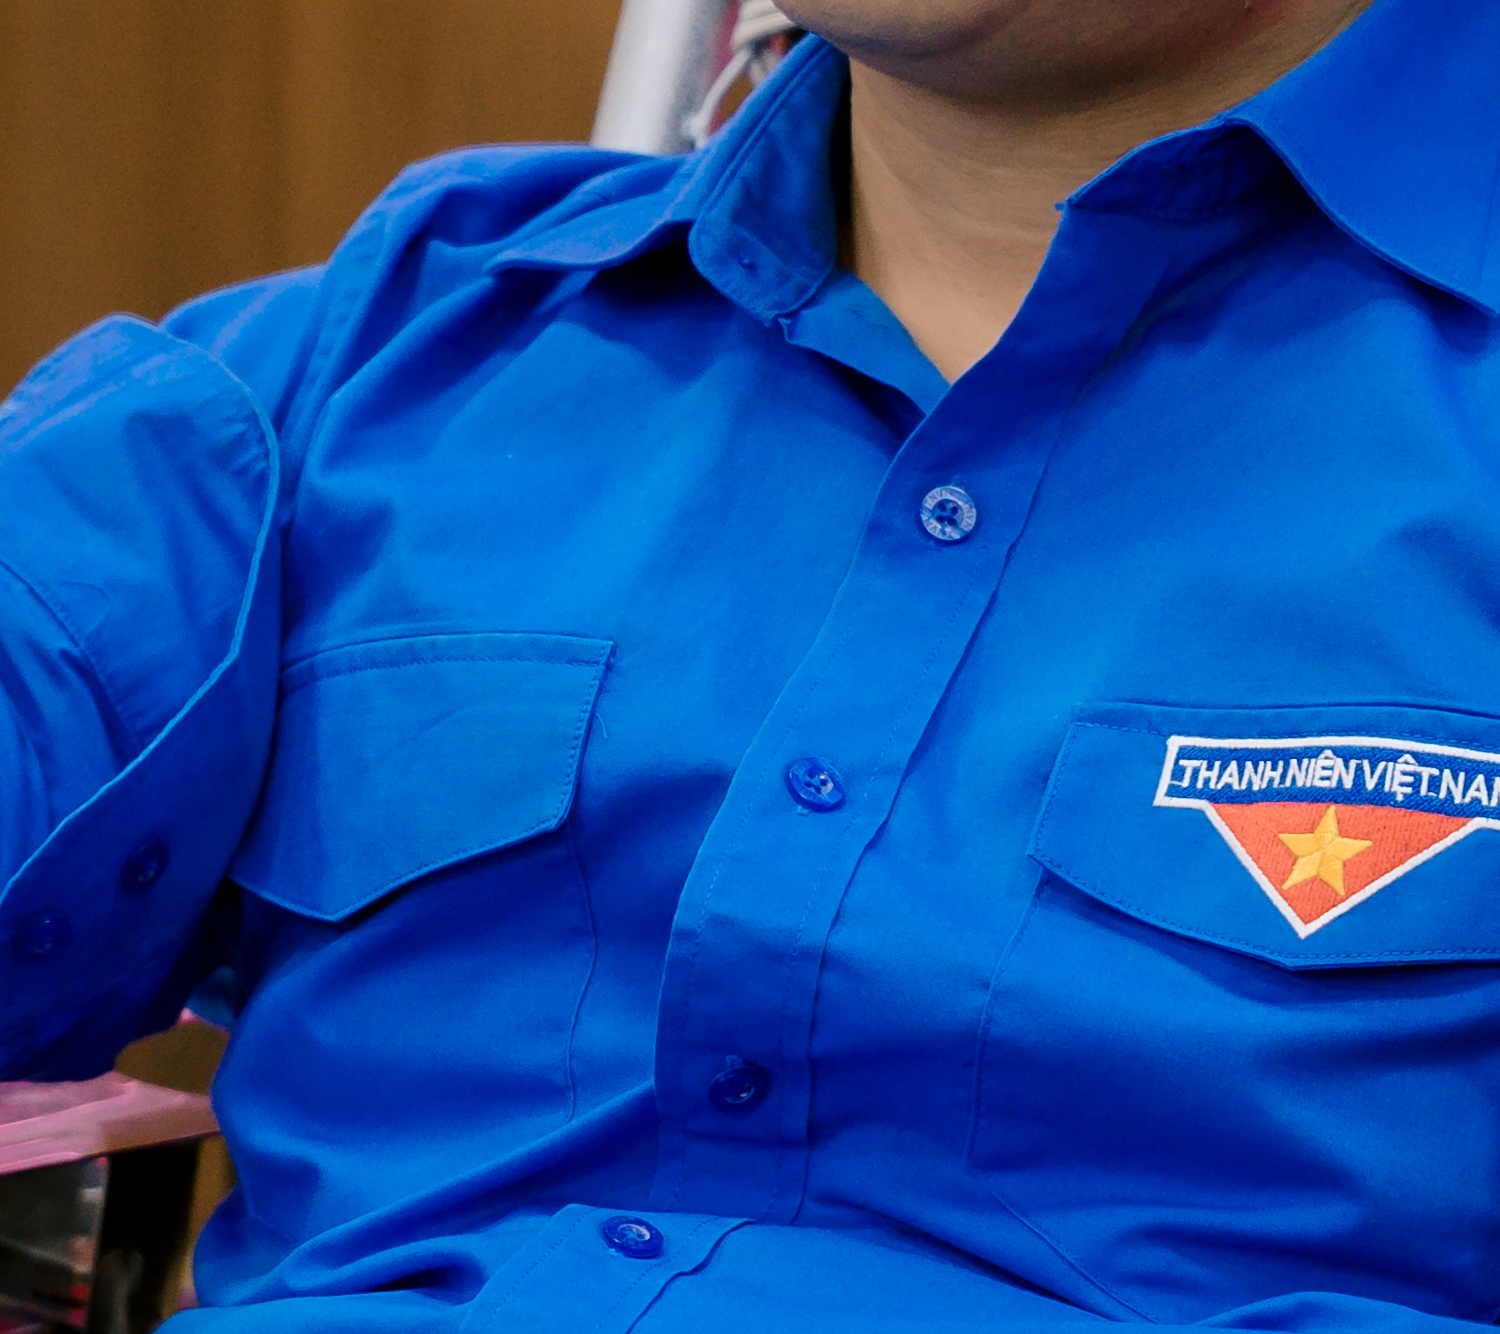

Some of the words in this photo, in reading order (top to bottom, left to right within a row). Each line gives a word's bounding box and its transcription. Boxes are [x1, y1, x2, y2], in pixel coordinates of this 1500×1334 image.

[1178, 759, 1284, 791] THANH
[1285, 749, 1356, 789] NIÊN
[1362, 753, 1440, 802] VIỆT
